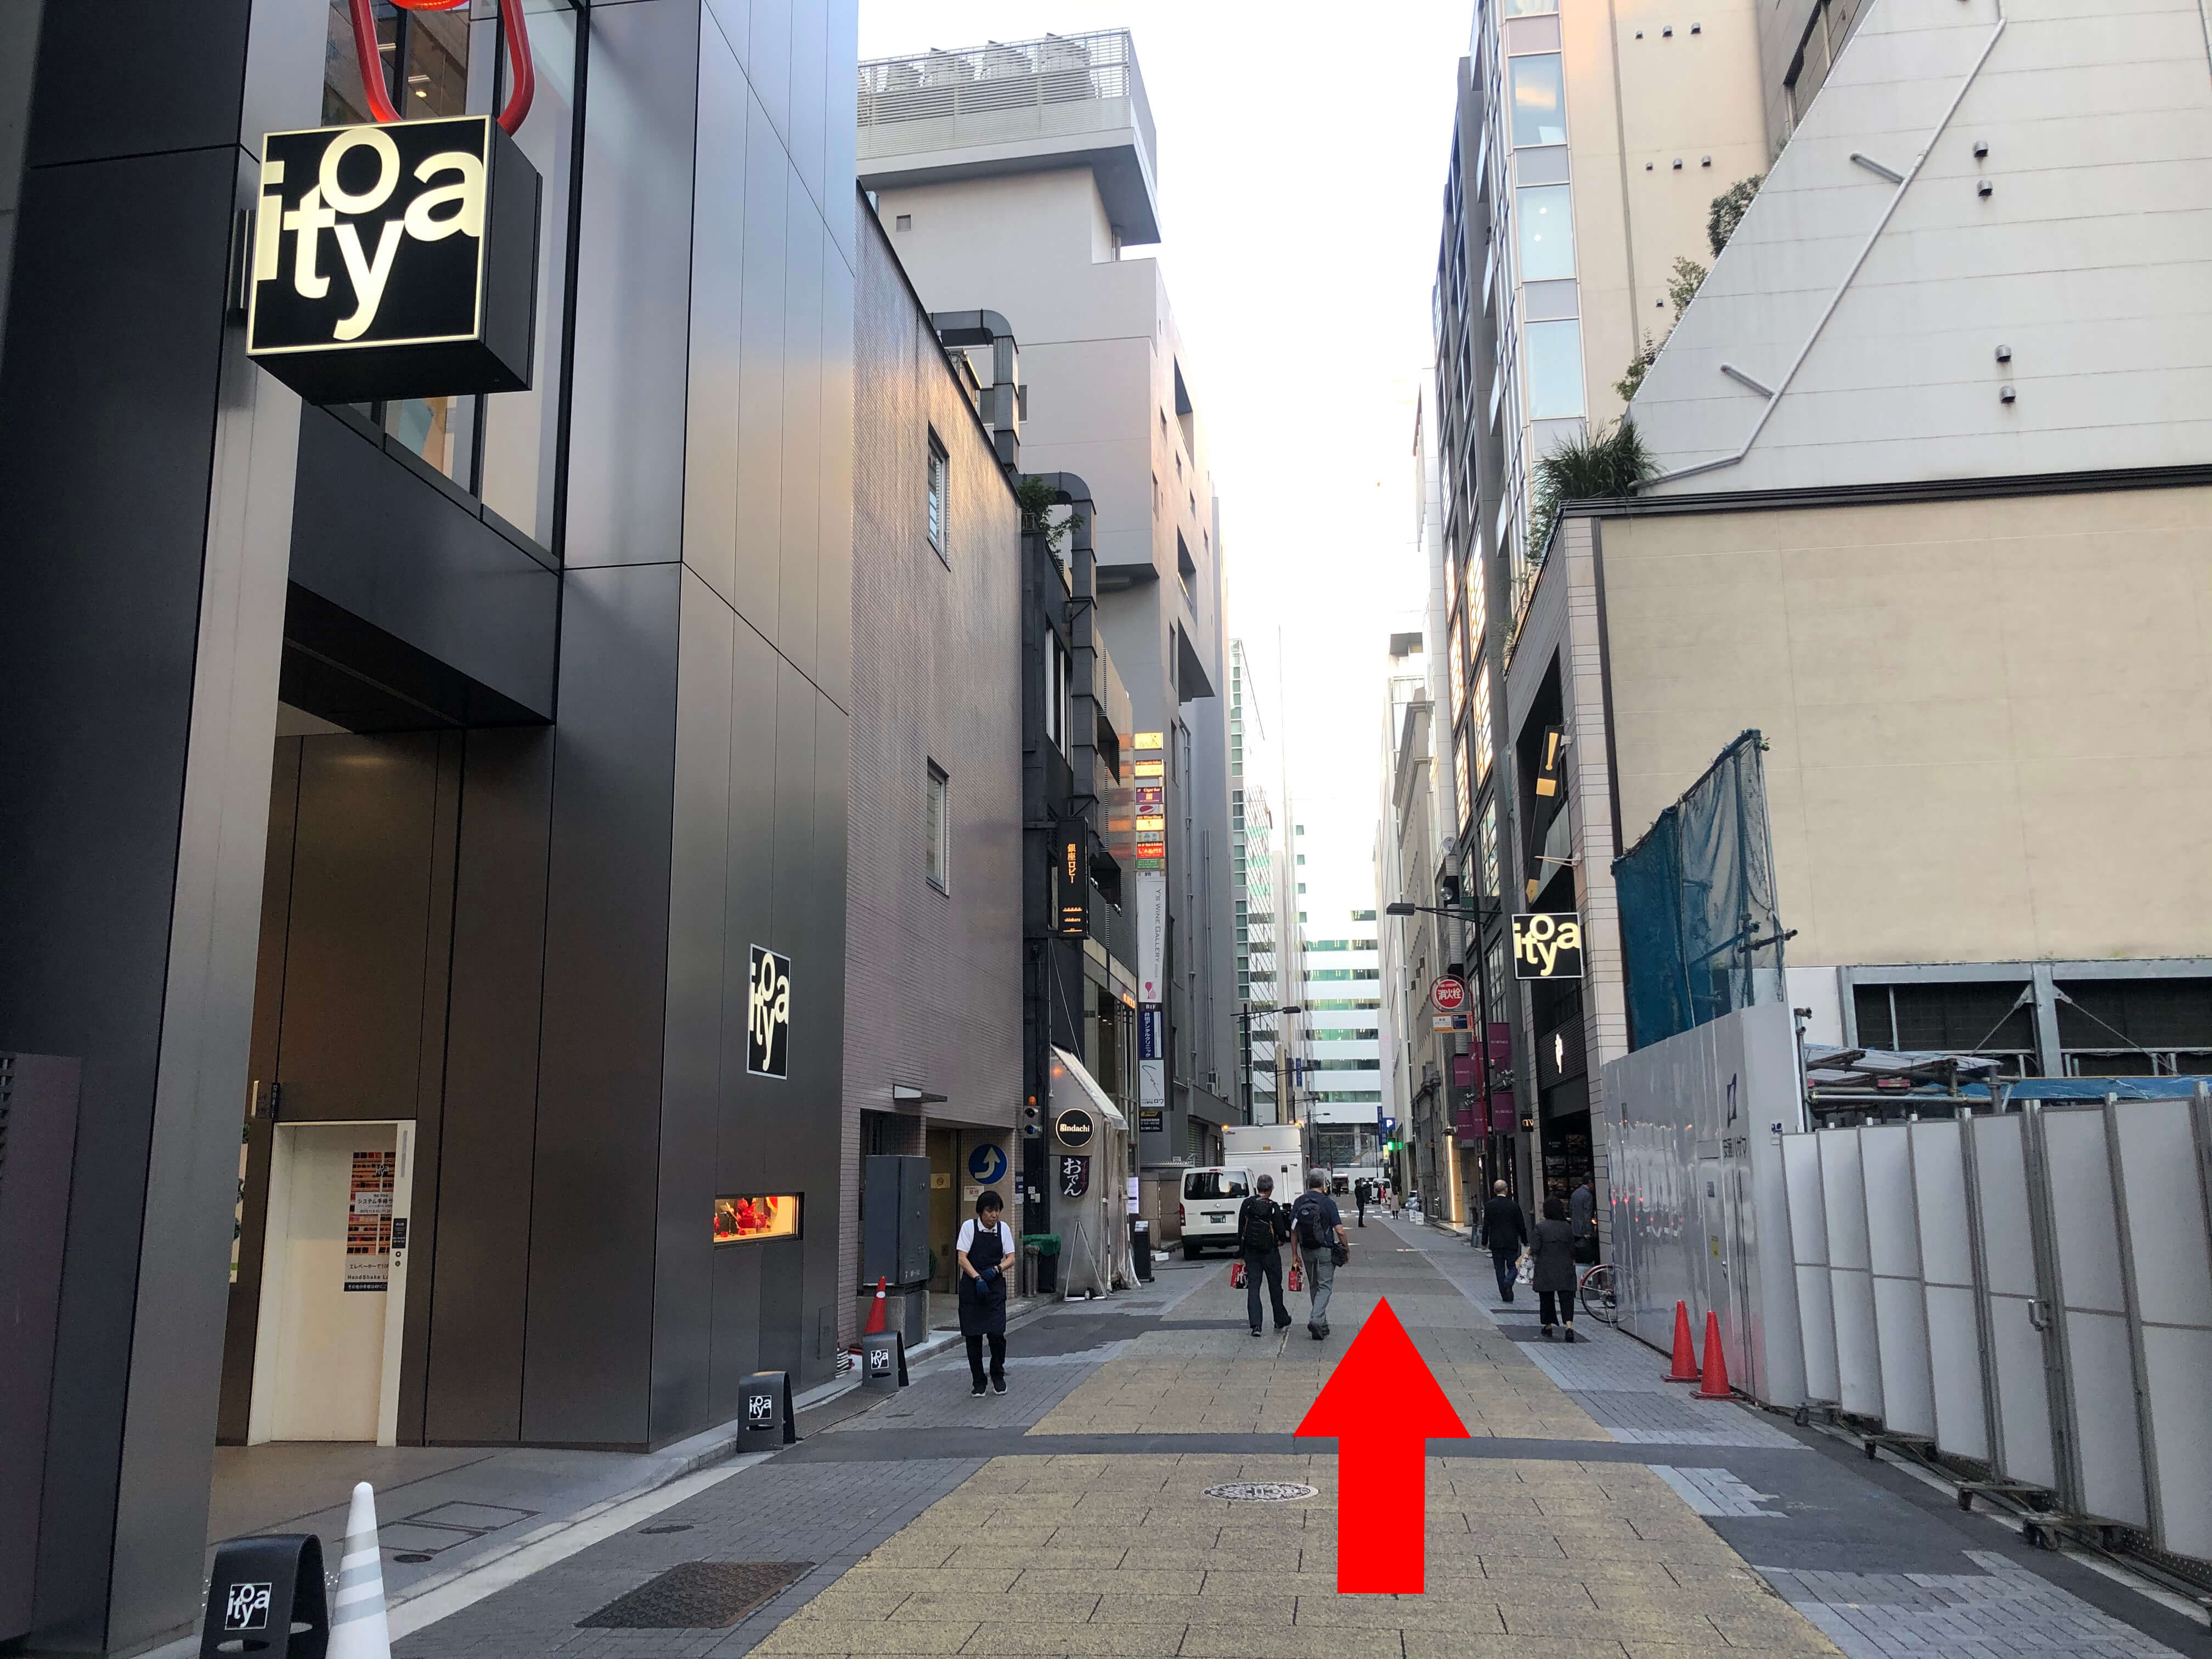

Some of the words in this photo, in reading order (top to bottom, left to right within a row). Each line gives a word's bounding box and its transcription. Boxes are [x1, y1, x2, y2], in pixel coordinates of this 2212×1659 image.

[1067, 843, 1076, 884] 銀座ロビー
[1437, 988, 1462, 1000] 消火栓
[1059, 1124, 1090, 1132] gindachi
[1386, 1119, 1393, 1128] P
[1063, 1158, 1082, 1197] おでん
